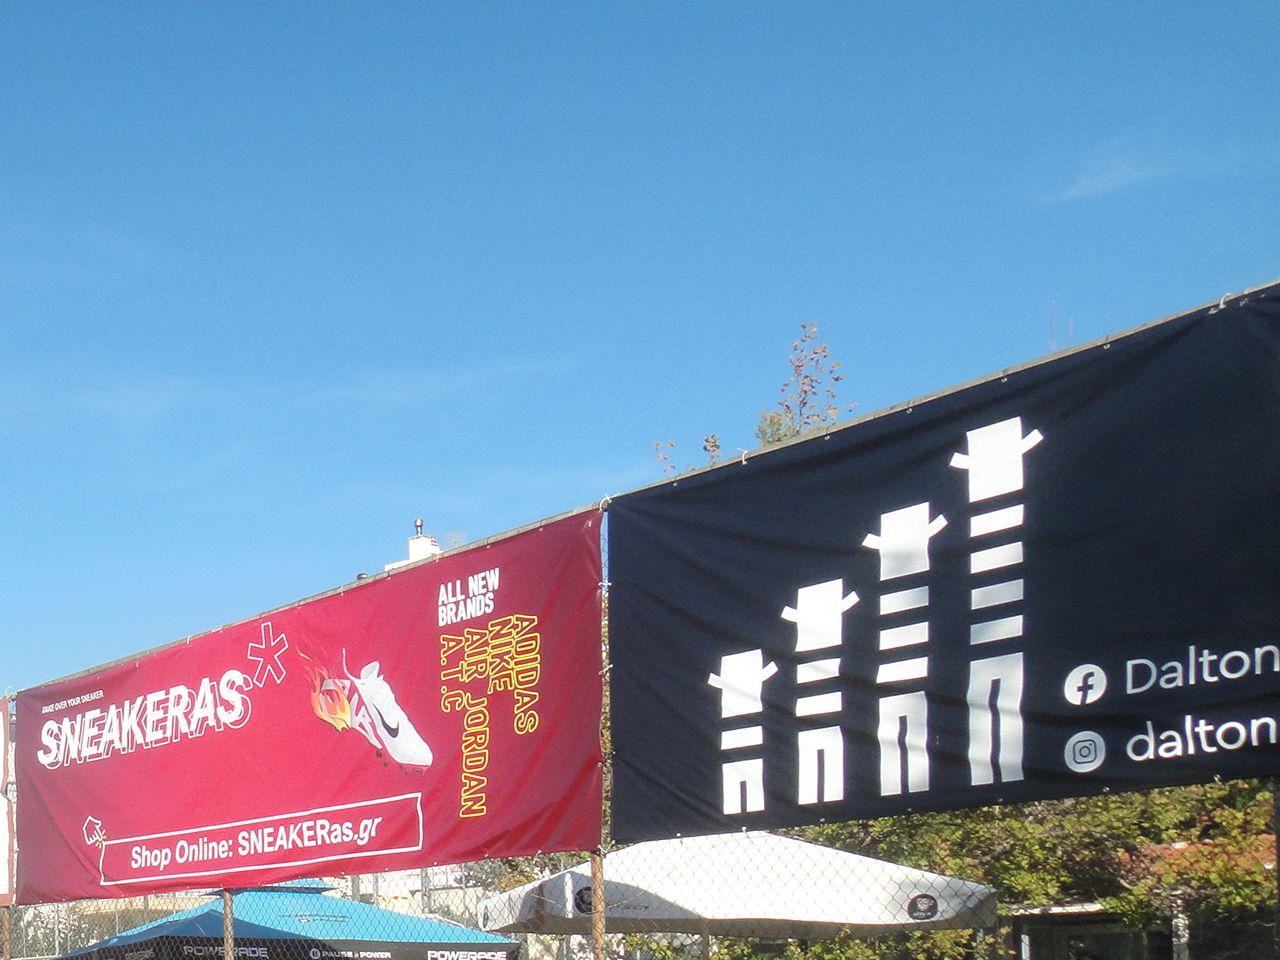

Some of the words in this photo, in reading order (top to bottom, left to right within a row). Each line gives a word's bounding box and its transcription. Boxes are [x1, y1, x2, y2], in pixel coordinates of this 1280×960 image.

[438, 580, 465, 606] ALL
[468, 567, 499, 597] NEW
[438, 592, 494, 627] BRANDS
[464, 628, 489, 682] AIR
[487, 616, 515, 694] NIKE
[513, 614, 540, 734] ADIDAS
[1126, 645, 1280, 694] Dalton
[37, 669, 252, 770] SNEAKERAS
[55, 700, 68, 711] OVER
[67, 696, 81, 707] YOUR
[81, 689, 104, 703] SNEAKER
[460, 692, 489, 817] JORDAN
[1126, 714, 1277, 762] dalton
[131, 846, 171, 871] Shop
[176, 840, 233, 864] Online:
[238, 816, 382, 856] SNEAKERas.gr
[322, 950, 353, 958] PAUSE
[360, 951, 392, 959] POWER
